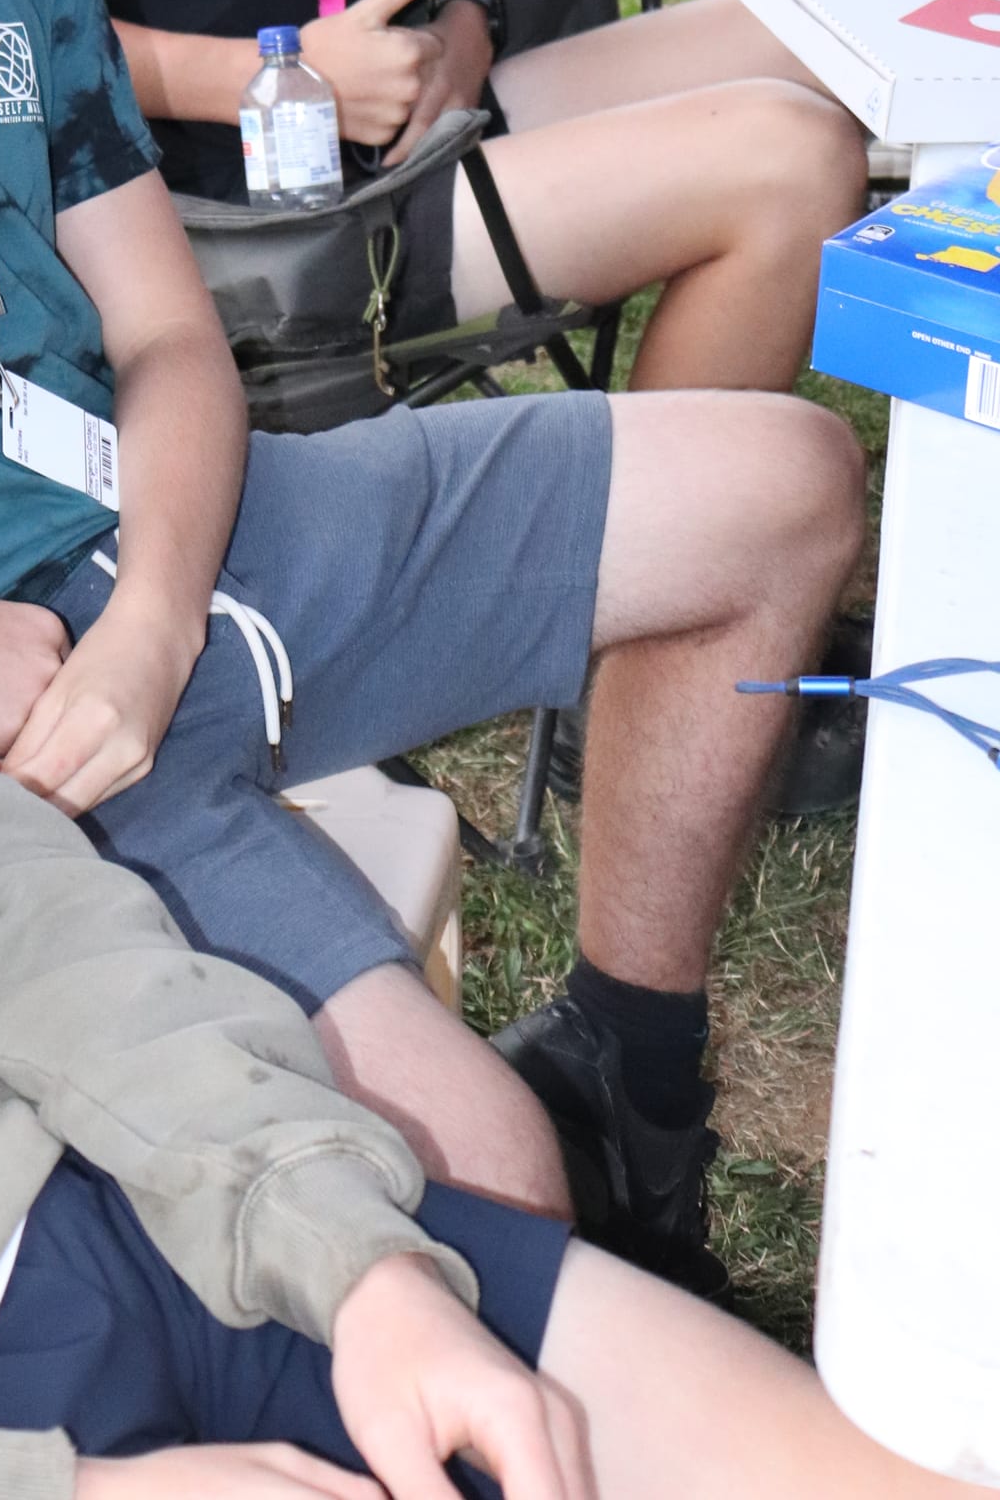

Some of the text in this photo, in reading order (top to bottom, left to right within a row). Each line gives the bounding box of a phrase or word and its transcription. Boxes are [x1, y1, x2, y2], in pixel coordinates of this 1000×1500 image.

[912, 330, 931, 343] OPEN
[932, 337, 955, 351] OTHER
[956, 344, 971, 356] END
